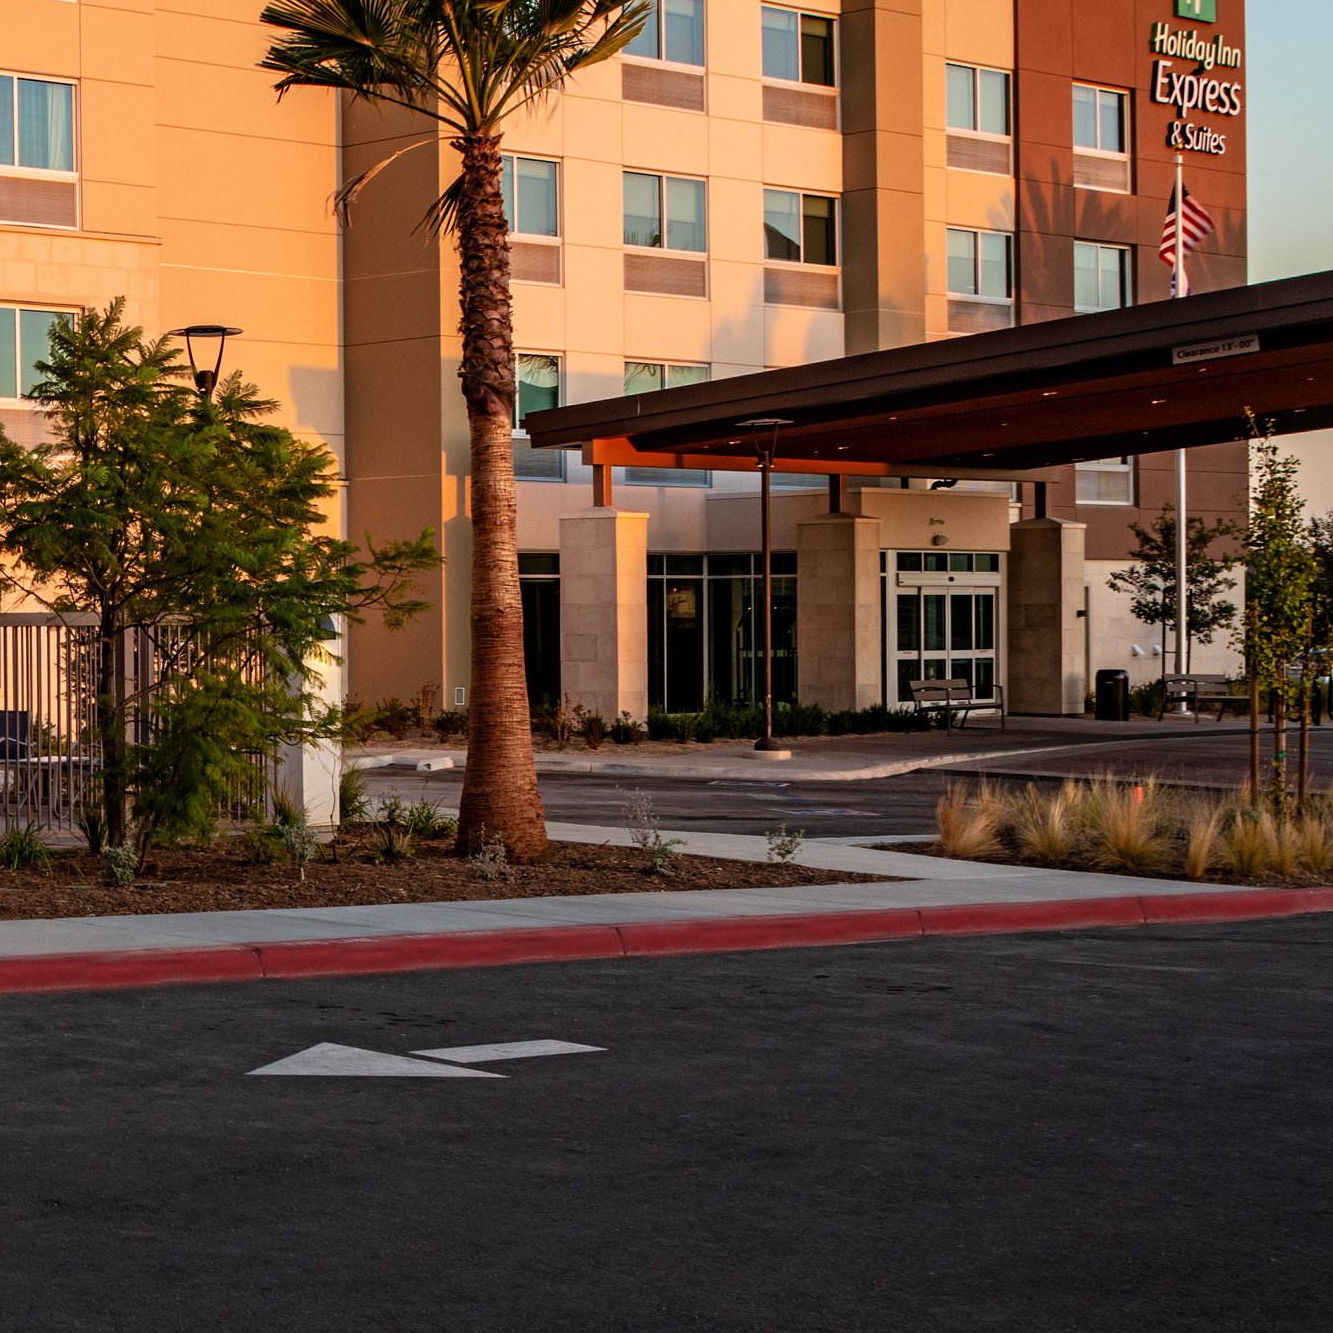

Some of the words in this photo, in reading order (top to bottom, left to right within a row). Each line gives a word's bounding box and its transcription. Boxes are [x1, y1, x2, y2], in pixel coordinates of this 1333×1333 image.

[1154, 22, 1216, 70] Holiday
[1217, 35, 1242, 68] Inn
[1155, 59, 1242, 118] Express
[1170, 121, 1183, 145] &
[1184, 123, 1226, 155] Suites
[1177, 346, 1219, 359] Clearance
